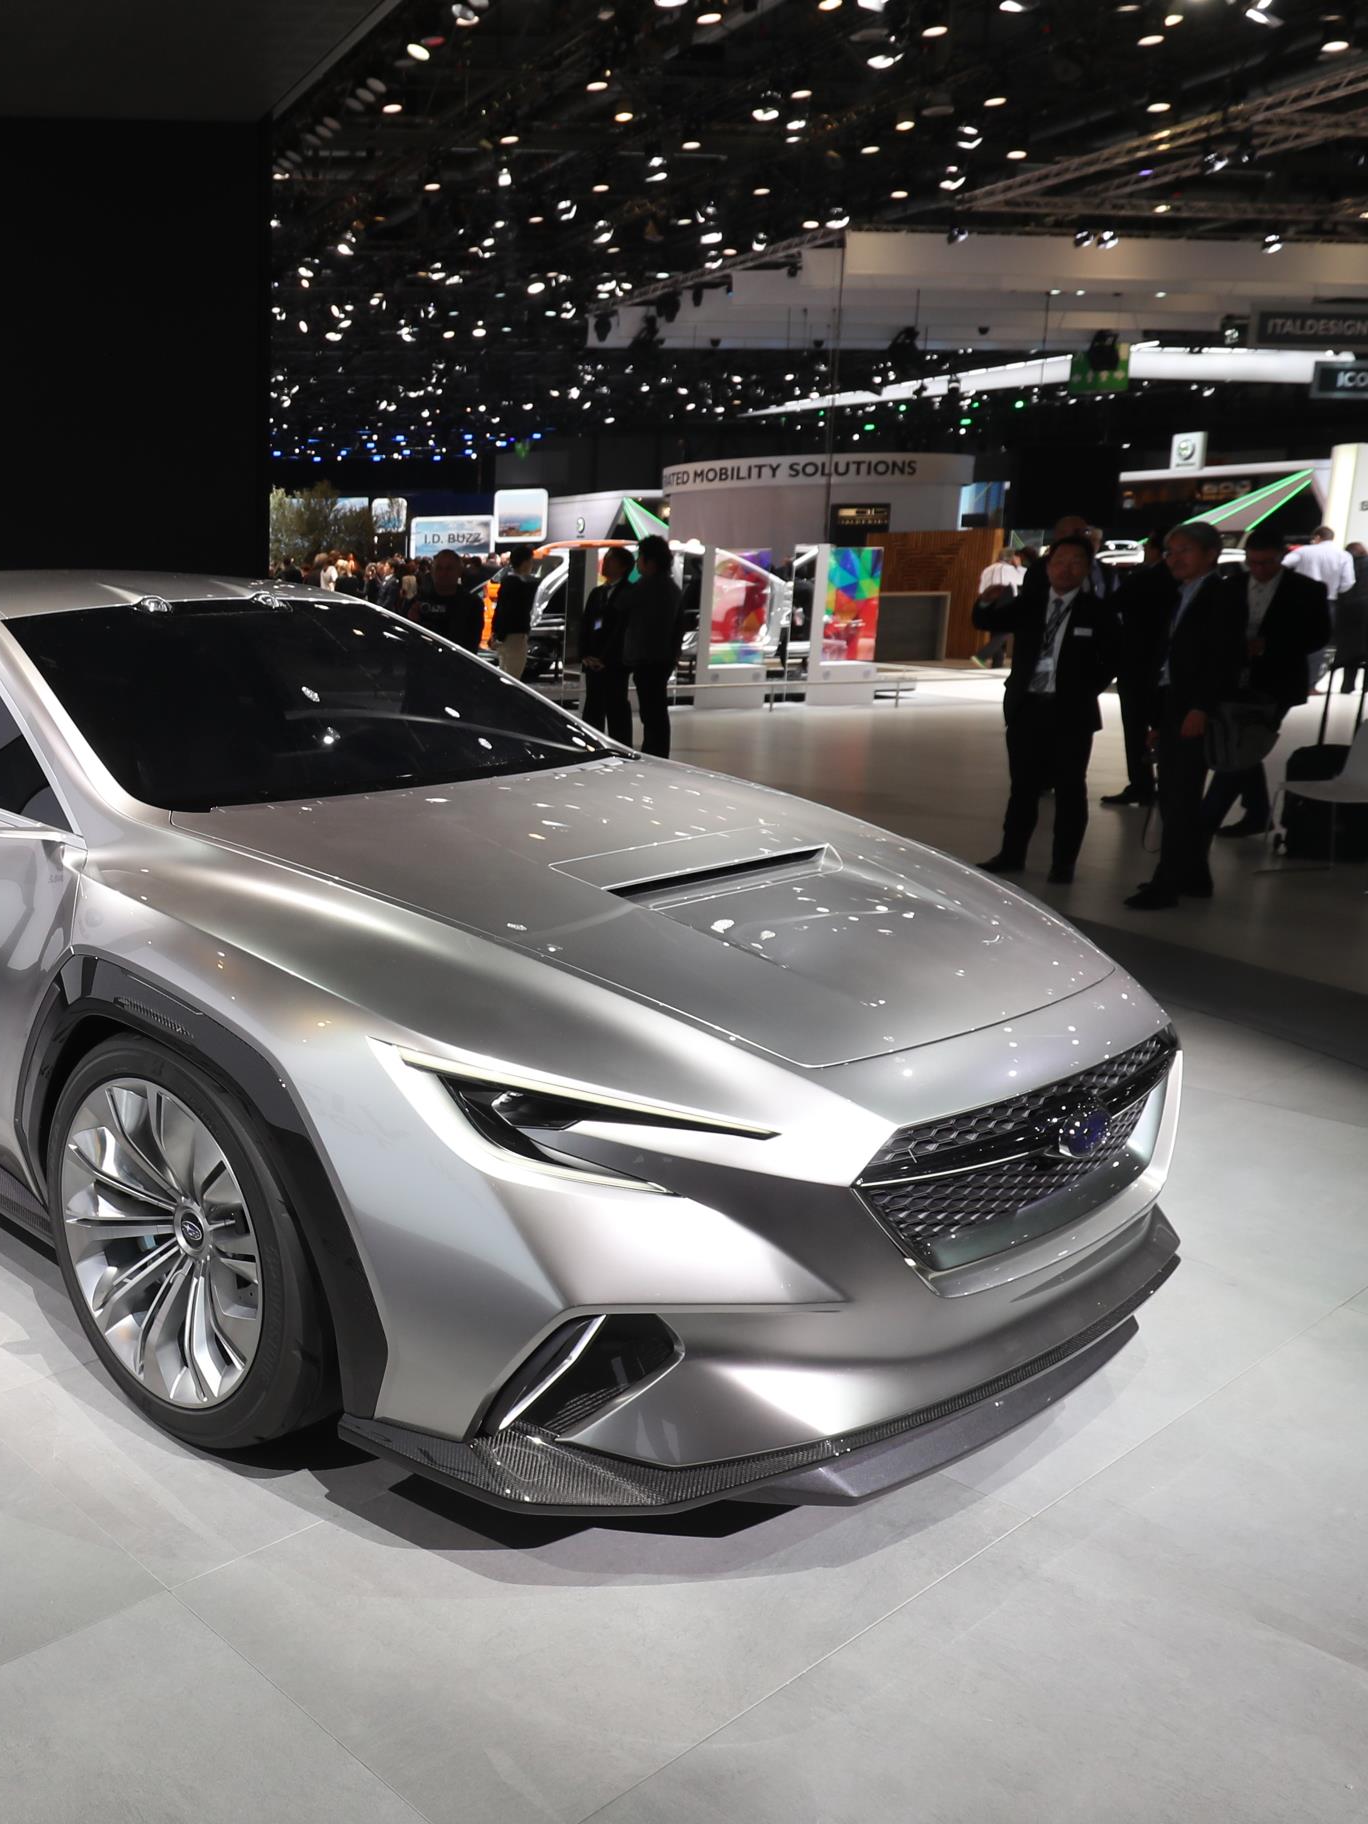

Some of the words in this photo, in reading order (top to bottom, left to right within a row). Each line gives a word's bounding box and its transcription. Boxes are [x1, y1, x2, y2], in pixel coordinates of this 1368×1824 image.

[1267, 318, 1368, 335] ITALDESIGN
[693, 463, 782, 483] MOBILITY
[788, 460, 918, 478] SOLUTIONS
[448, 532, 482, 544] BUZZ
